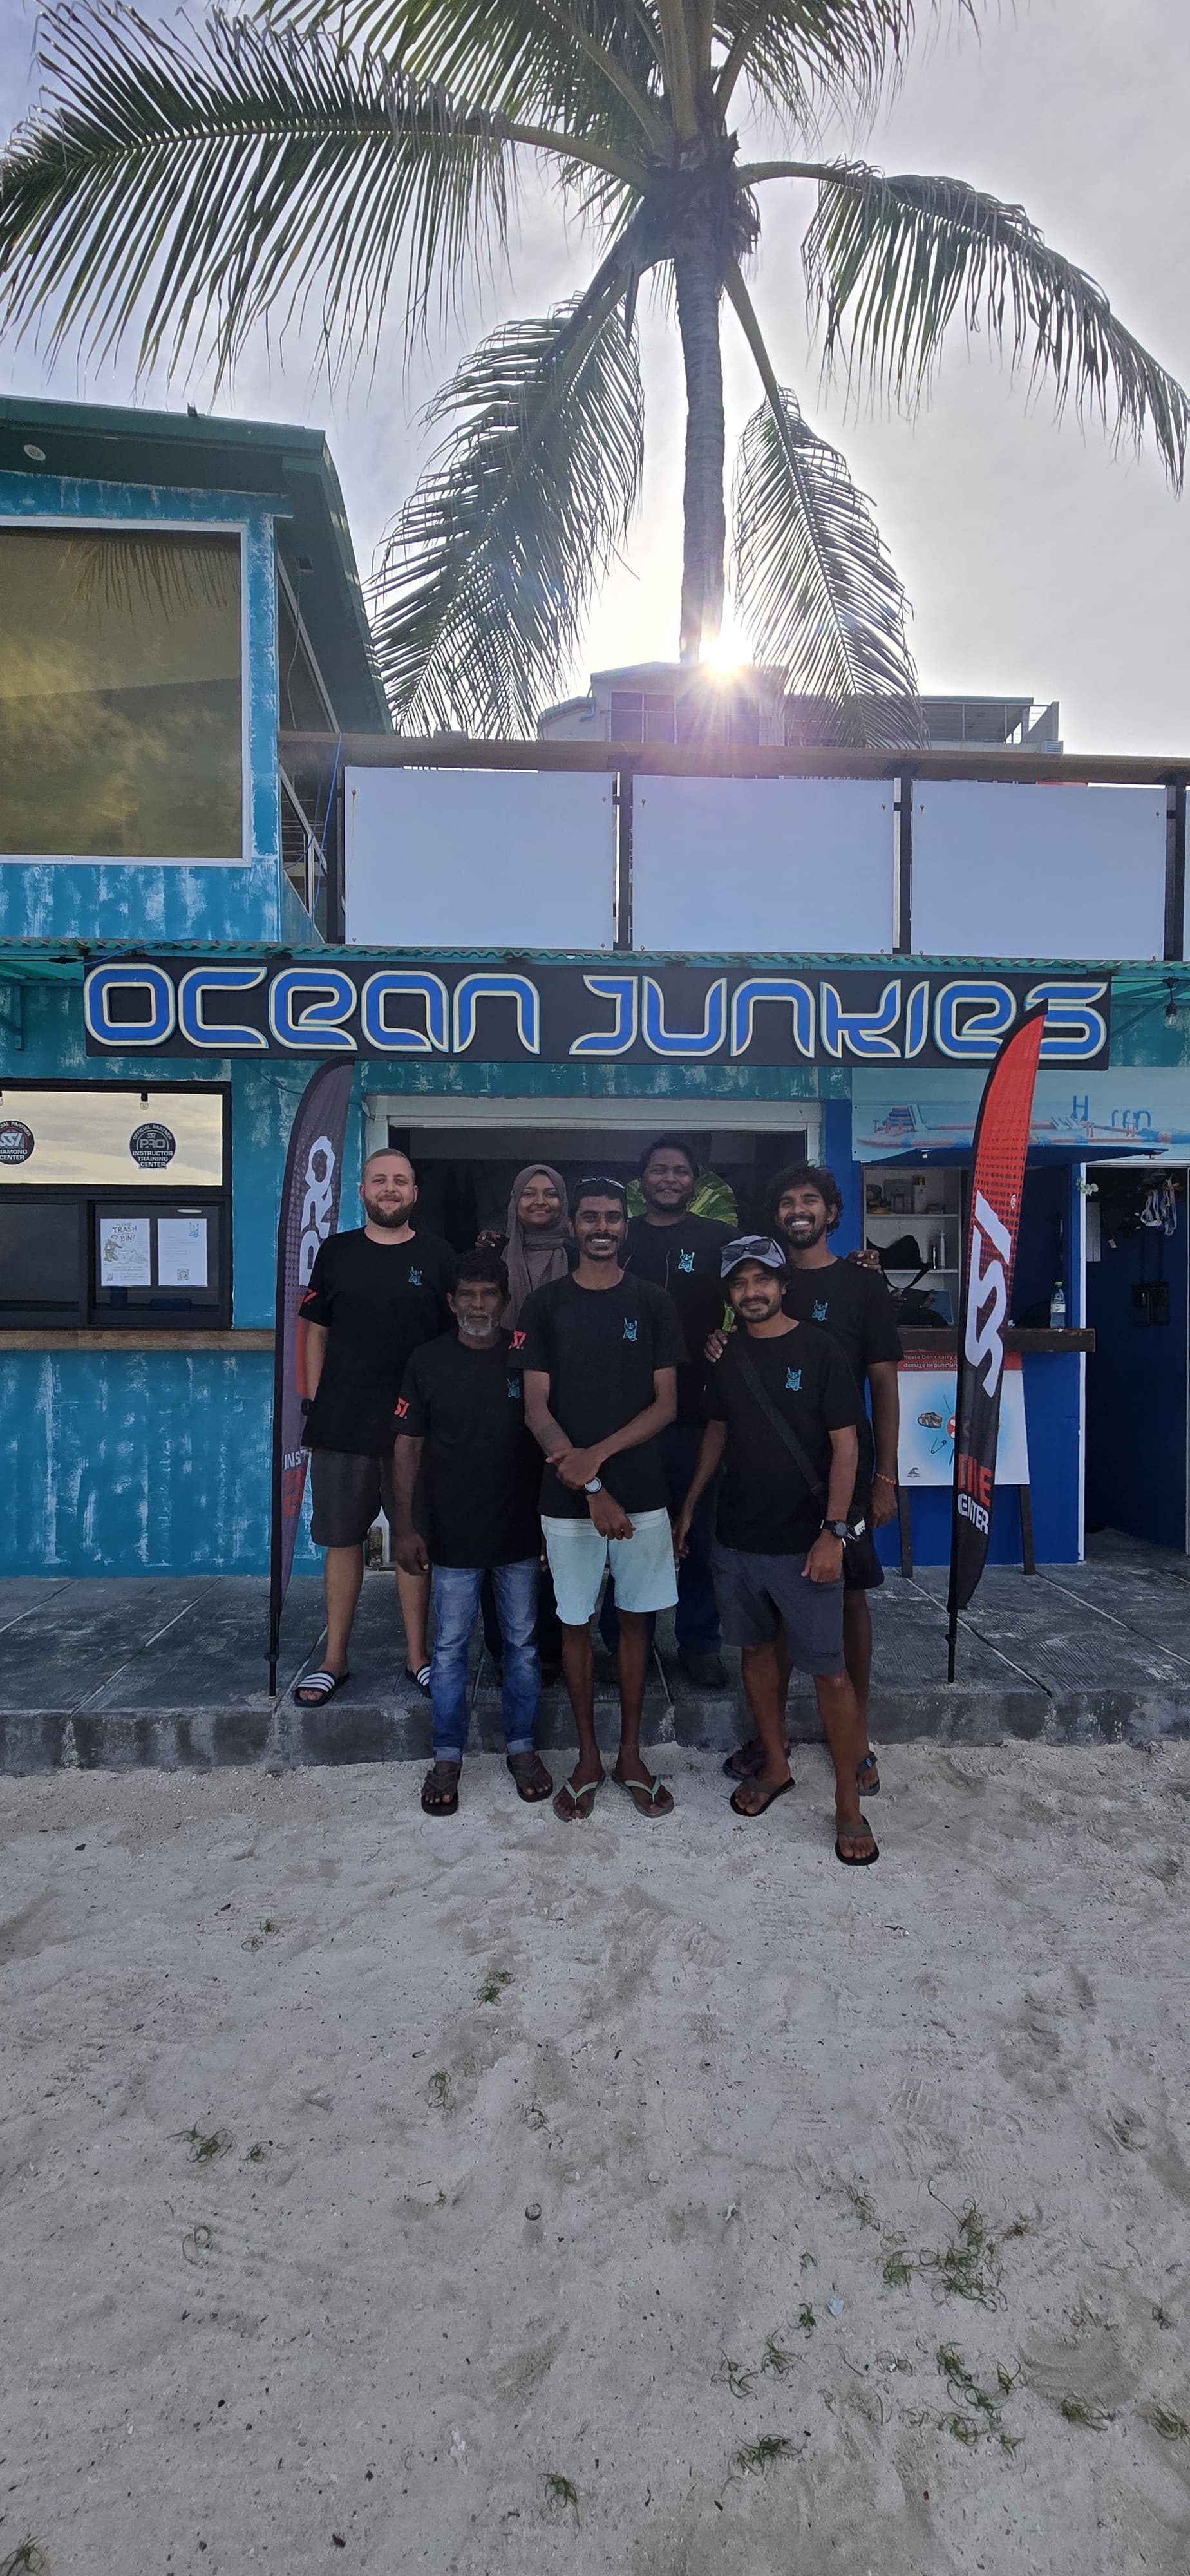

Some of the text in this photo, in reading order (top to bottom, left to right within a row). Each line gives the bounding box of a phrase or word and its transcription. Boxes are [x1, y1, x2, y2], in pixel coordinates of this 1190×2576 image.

[140, 1139, 166, 1148] PRO
[965, 1189, 1012, 1398] SSI
[958, 1493, 990, 1535] CENTER
